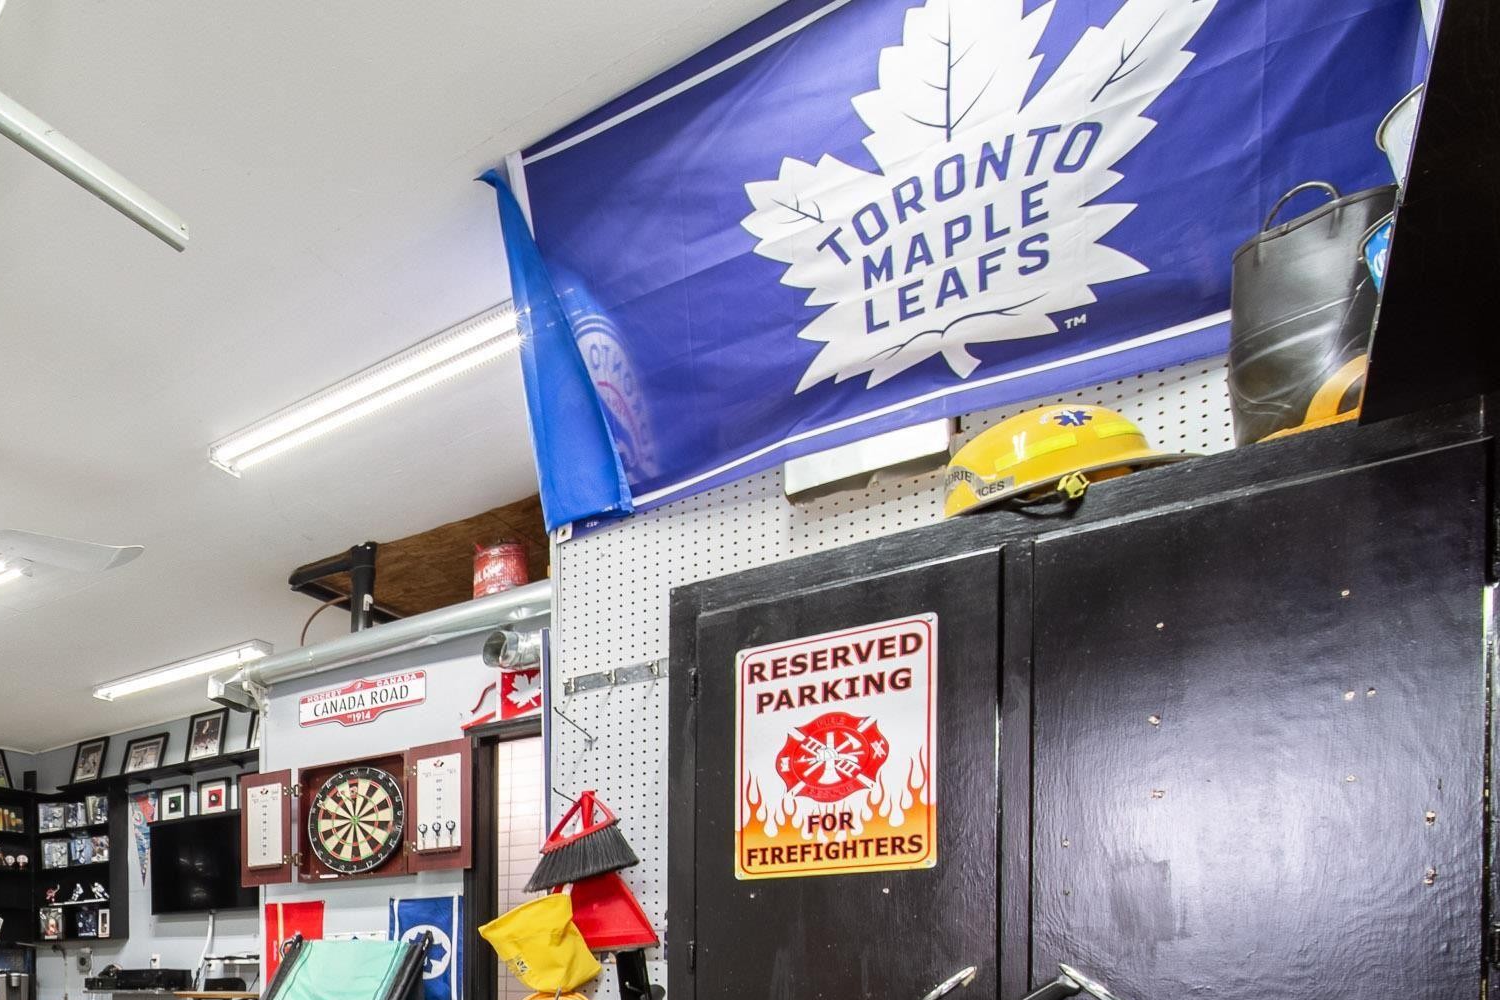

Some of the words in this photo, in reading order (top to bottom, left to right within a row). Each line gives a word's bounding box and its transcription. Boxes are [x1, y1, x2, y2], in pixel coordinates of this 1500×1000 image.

[816, 120, 1104, 269] TORONTO
[861, 180, 1050, 291] MAPLE
[864, 232, 1050, 335] LEAFS
[1064, 312, 1088, 330] TM
[945, 470, 972, 488] DRIE
[976, 480, 1005, 497] ICES
[747, 632, 924, 685] RESERVED
[307, 690, 342, 703] HOCKEY
[376, 673, 417, 687] CANADA
[313, 694, 365, 717] CANADA
[370, 685, 409, 705] ROAD
[756, 667, 912, 714] PARKING
[352, 711, 371, 722] 1914
[807, 811, 854, 834] FOR
[746, 834, 923, 867] FIREFIGHTERS
